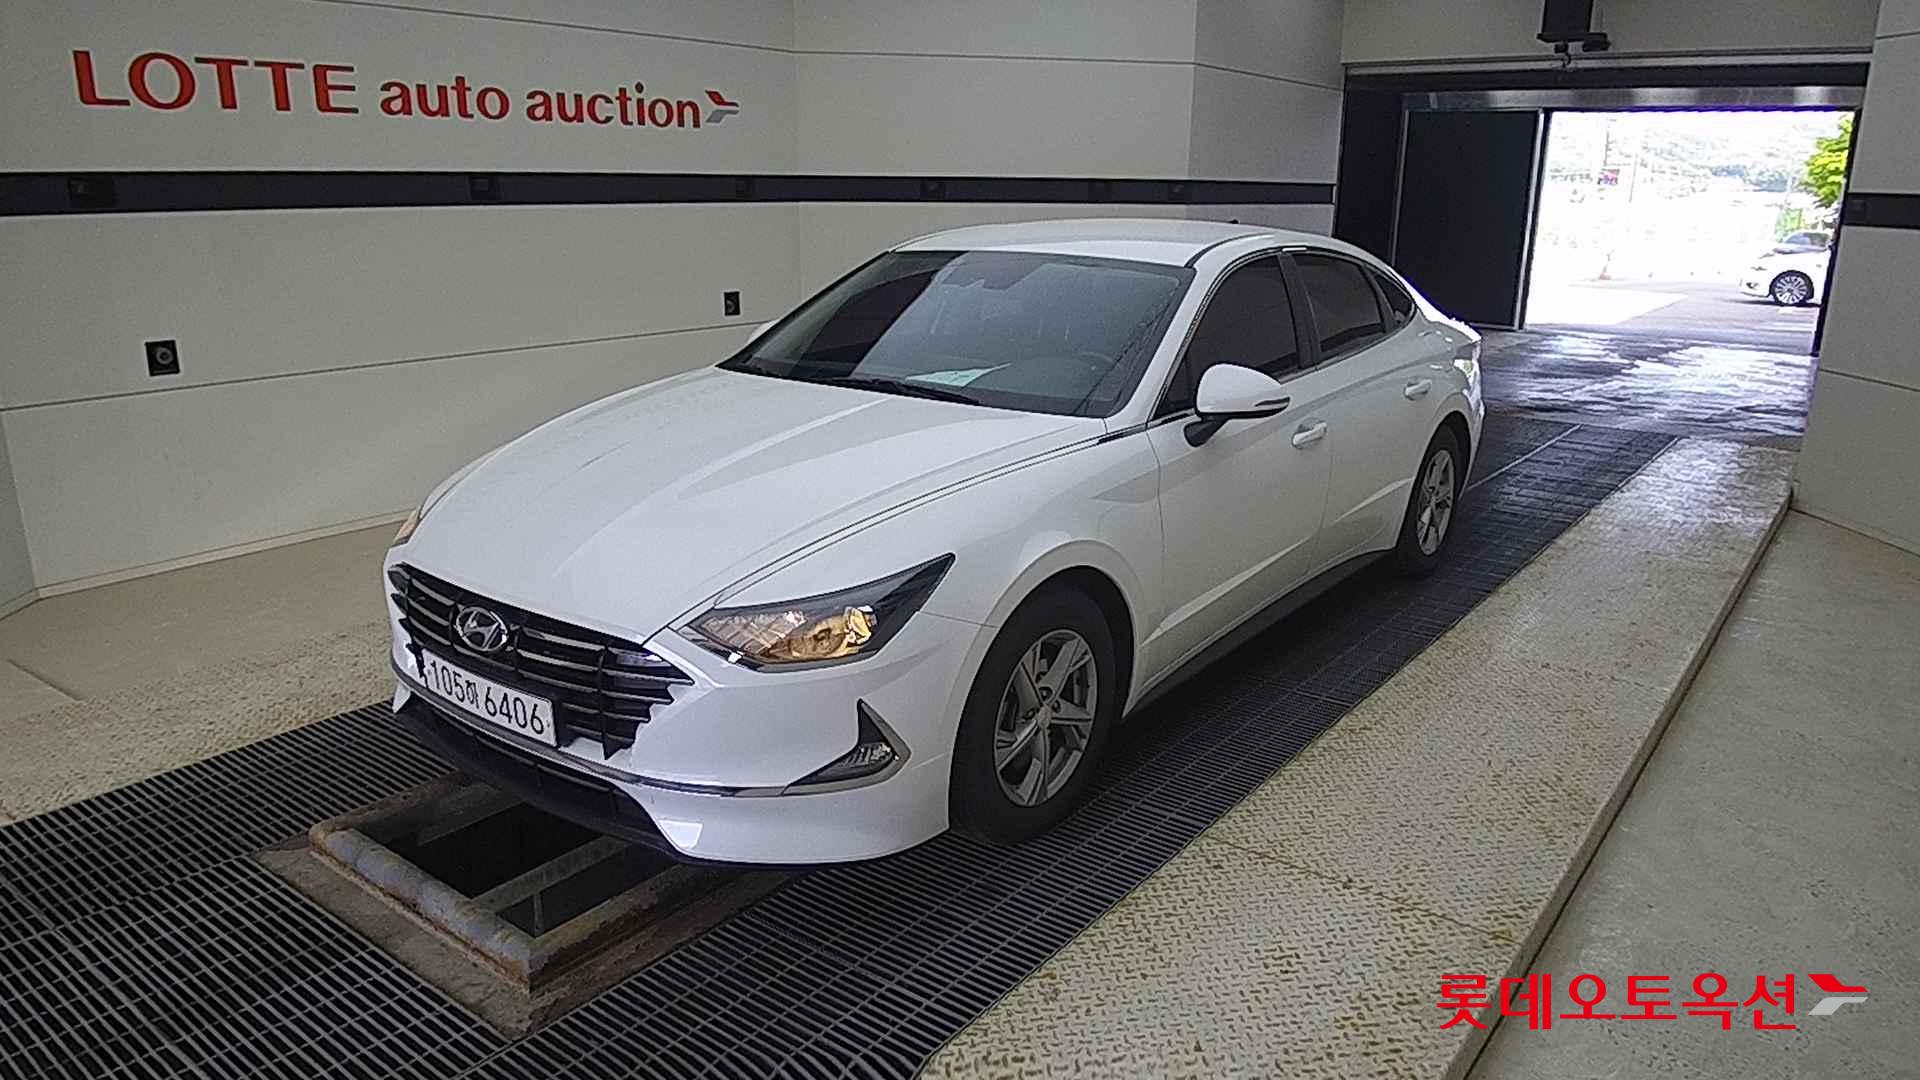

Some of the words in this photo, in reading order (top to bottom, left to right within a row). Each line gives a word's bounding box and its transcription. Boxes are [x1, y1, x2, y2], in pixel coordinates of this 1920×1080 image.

[73, 50, 360, 114] LOTTE
[379, 76, 509, 120] auto
[525, 82, 701, 128] auction
[484, 686, 545, 735] 6406
